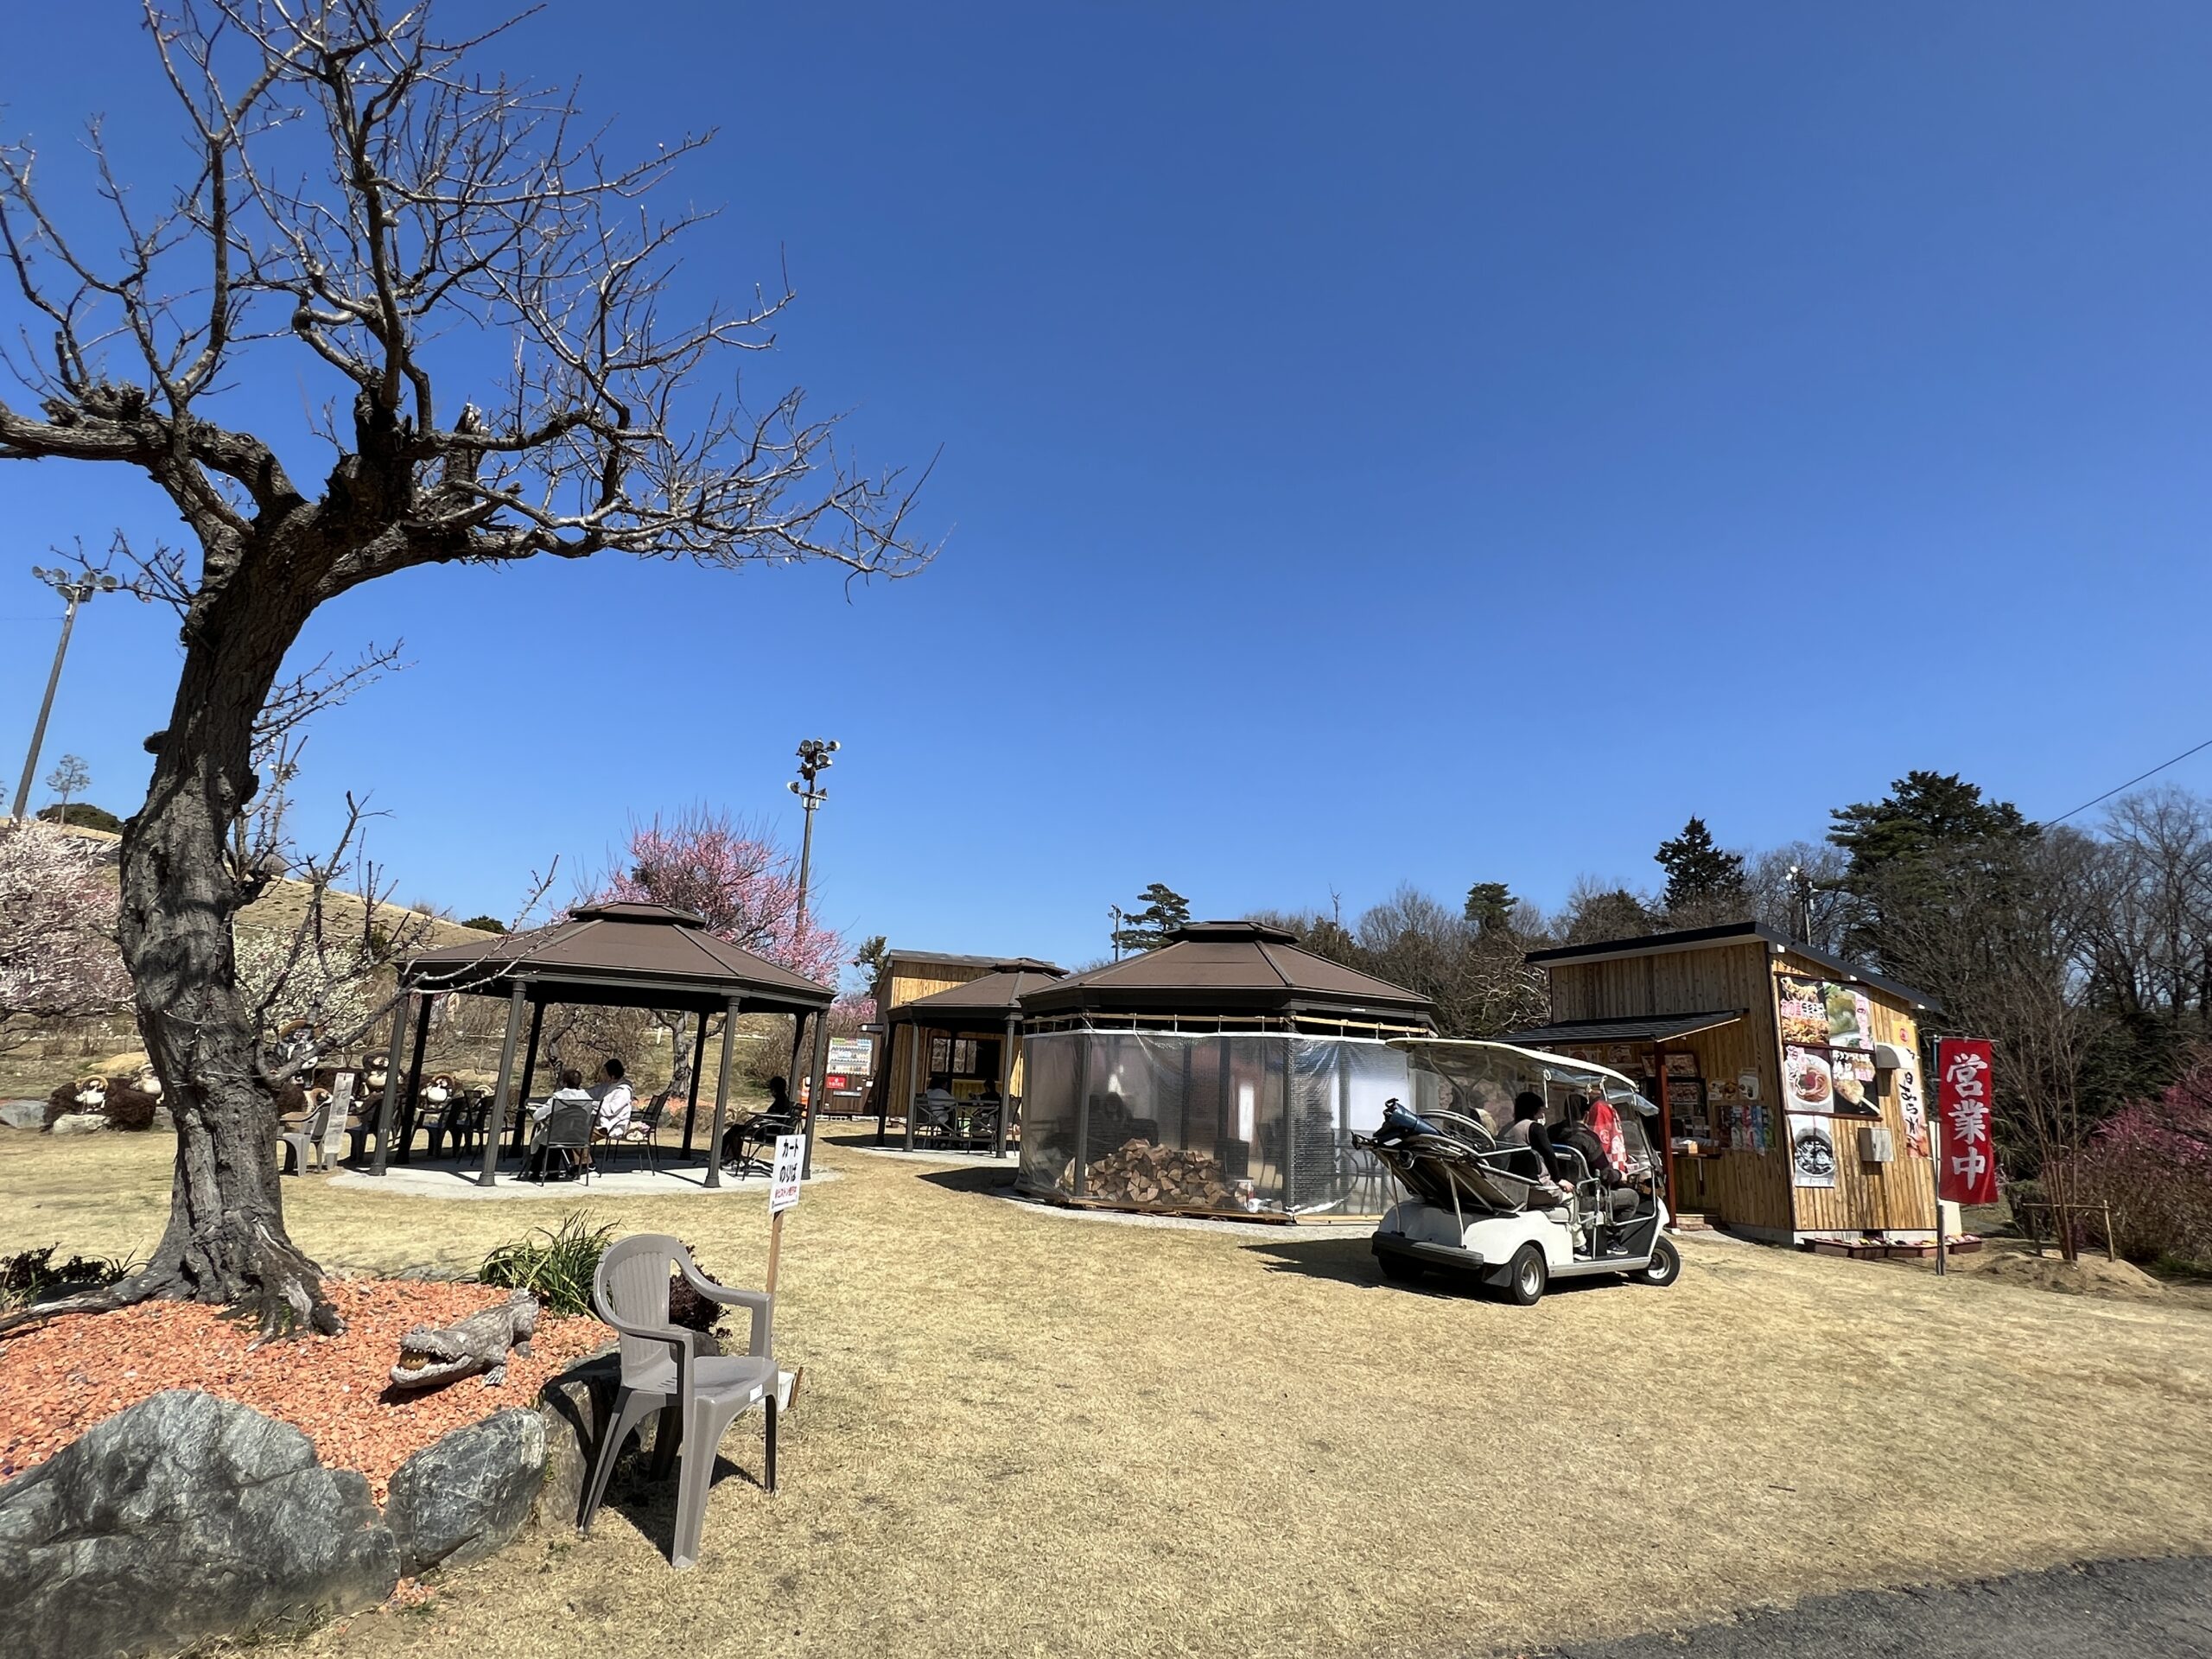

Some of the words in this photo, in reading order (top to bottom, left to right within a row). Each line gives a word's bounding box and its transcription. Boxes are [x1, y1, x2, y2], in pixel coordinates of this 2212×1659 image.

[1946, 1052, 1989, 1191] 営業中
[782, 1138, 799, 1158] カート
[779, 1163, 798, 1183] のりば
